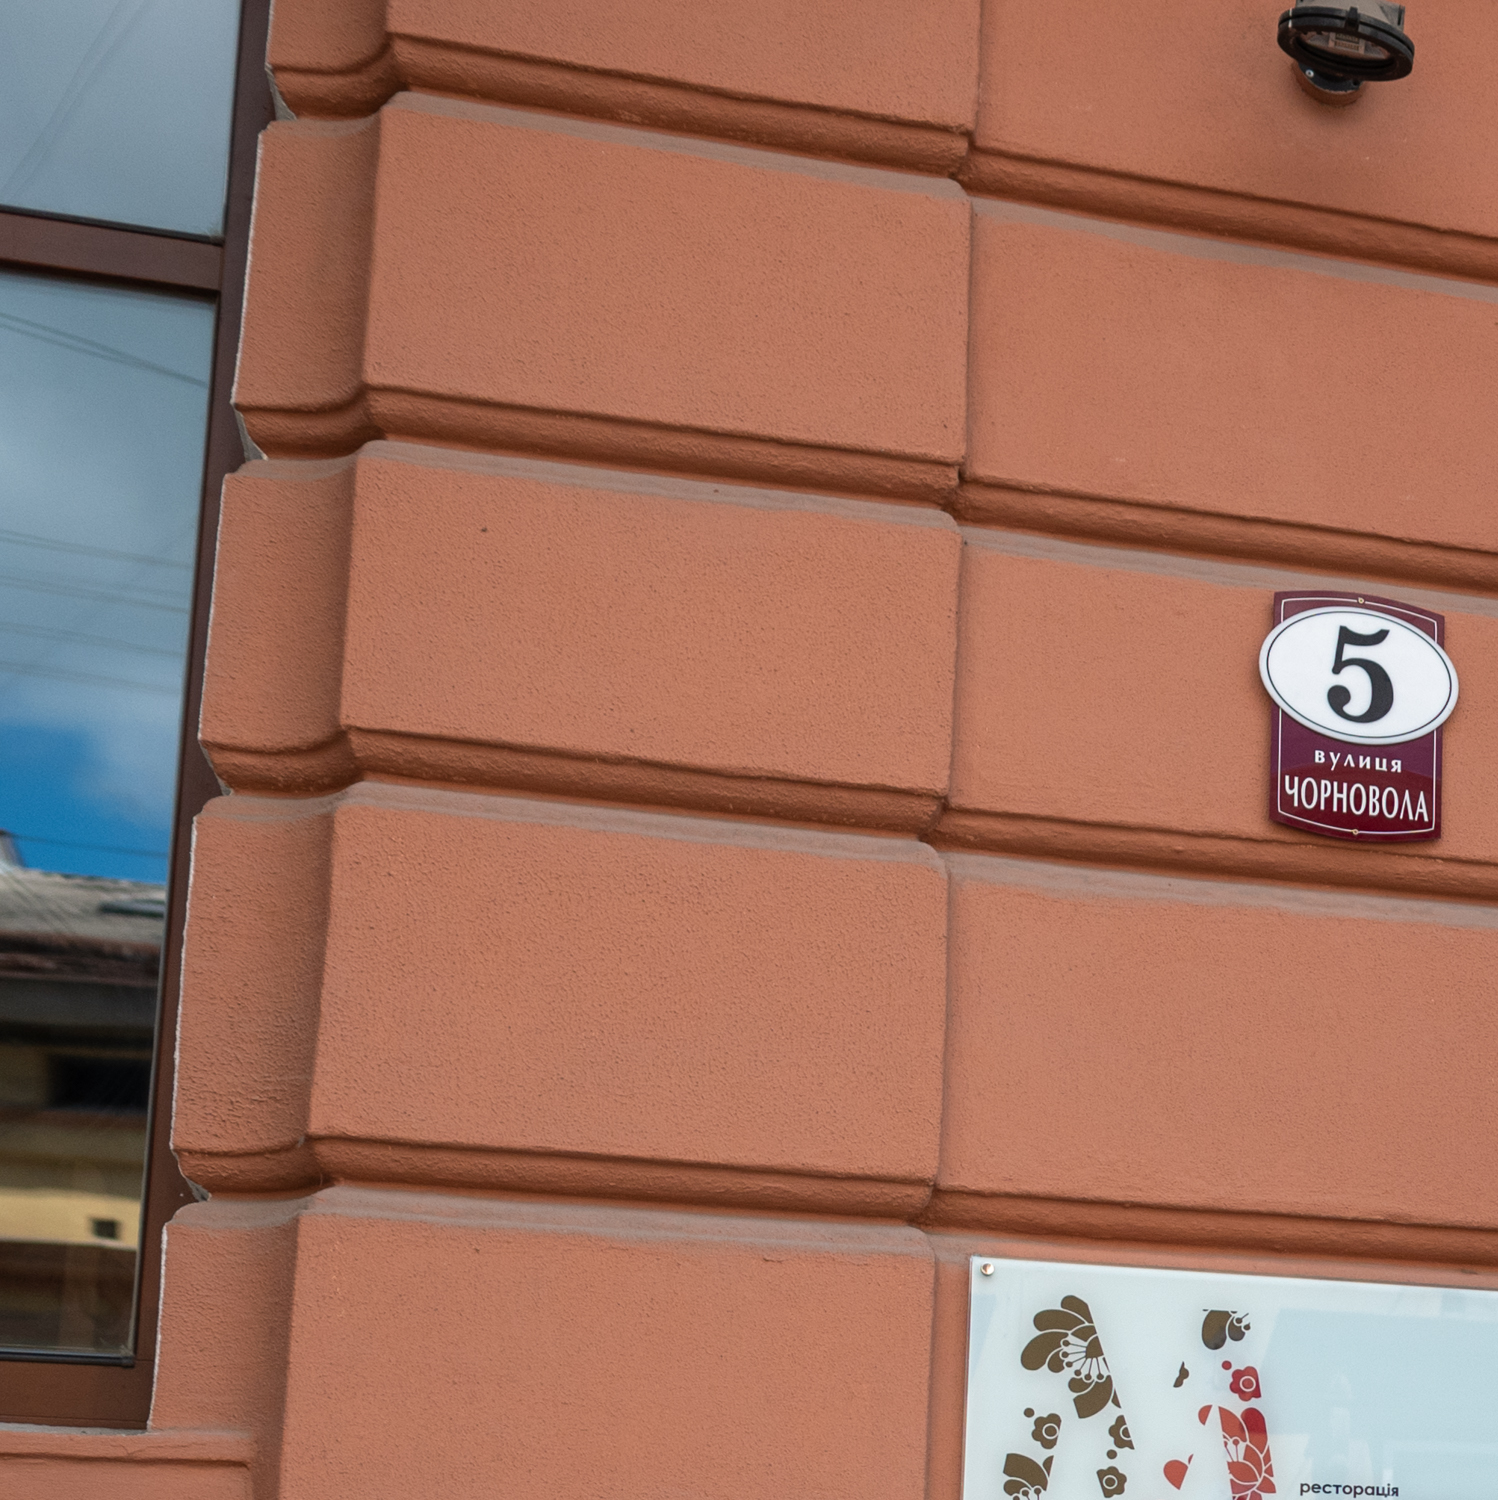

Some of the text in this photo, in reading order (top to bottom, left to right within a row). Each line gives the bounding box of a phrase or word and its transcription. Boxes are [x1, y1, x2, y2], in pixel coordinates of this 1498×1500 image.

[1327, 625, 1394, 723] 5
[1314, 749, 1402, 773] вулиця
[1284, 774, 1429, 822] ЧОРНОВОЛА
[1299, 1482, 1399, 1498] ресторація
